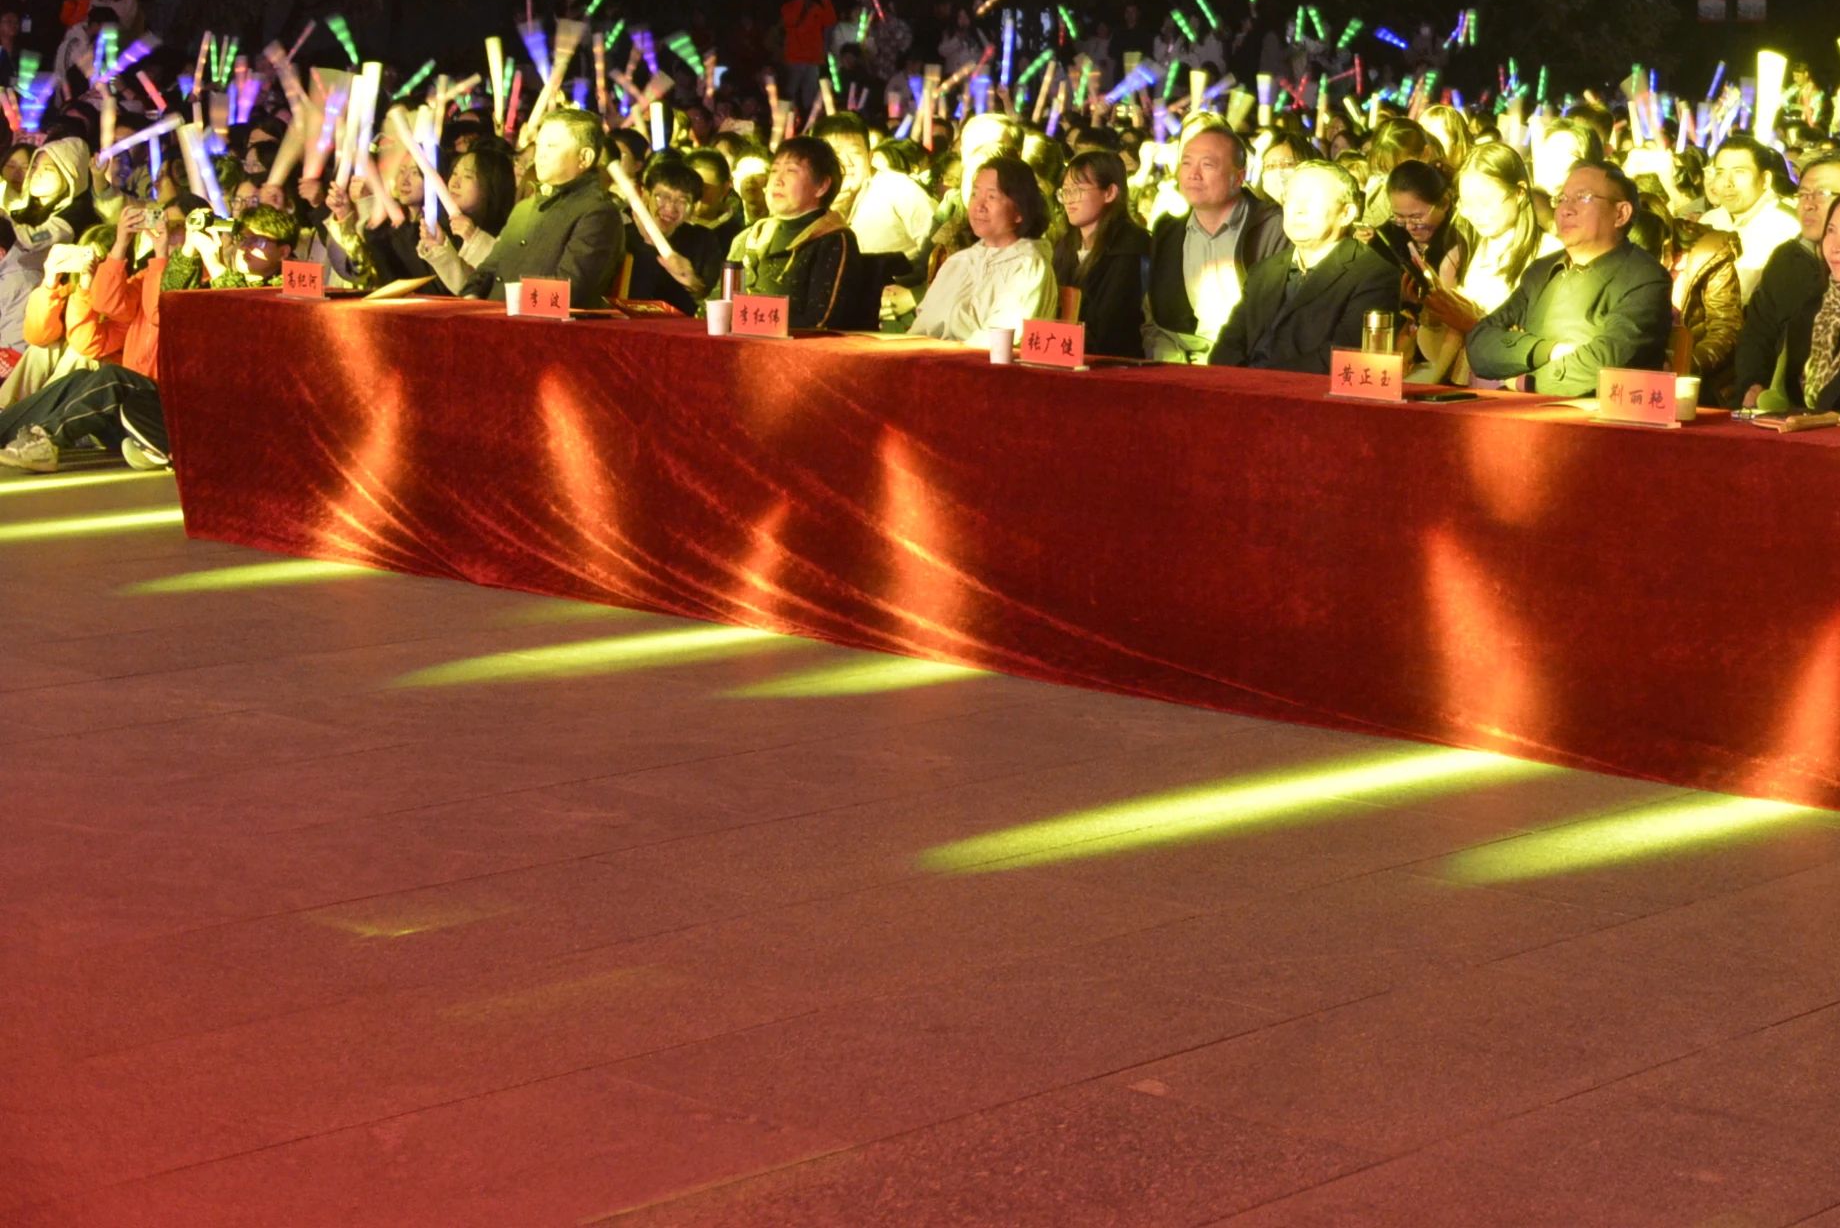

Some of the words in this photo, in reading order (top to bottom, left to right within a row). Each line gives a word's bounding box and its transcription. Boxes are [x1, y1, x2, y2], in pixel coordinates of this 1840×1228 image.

[1027, 332, 1075, 357] 张广健
[1338, 364, 1391, 388] 黄正玉
